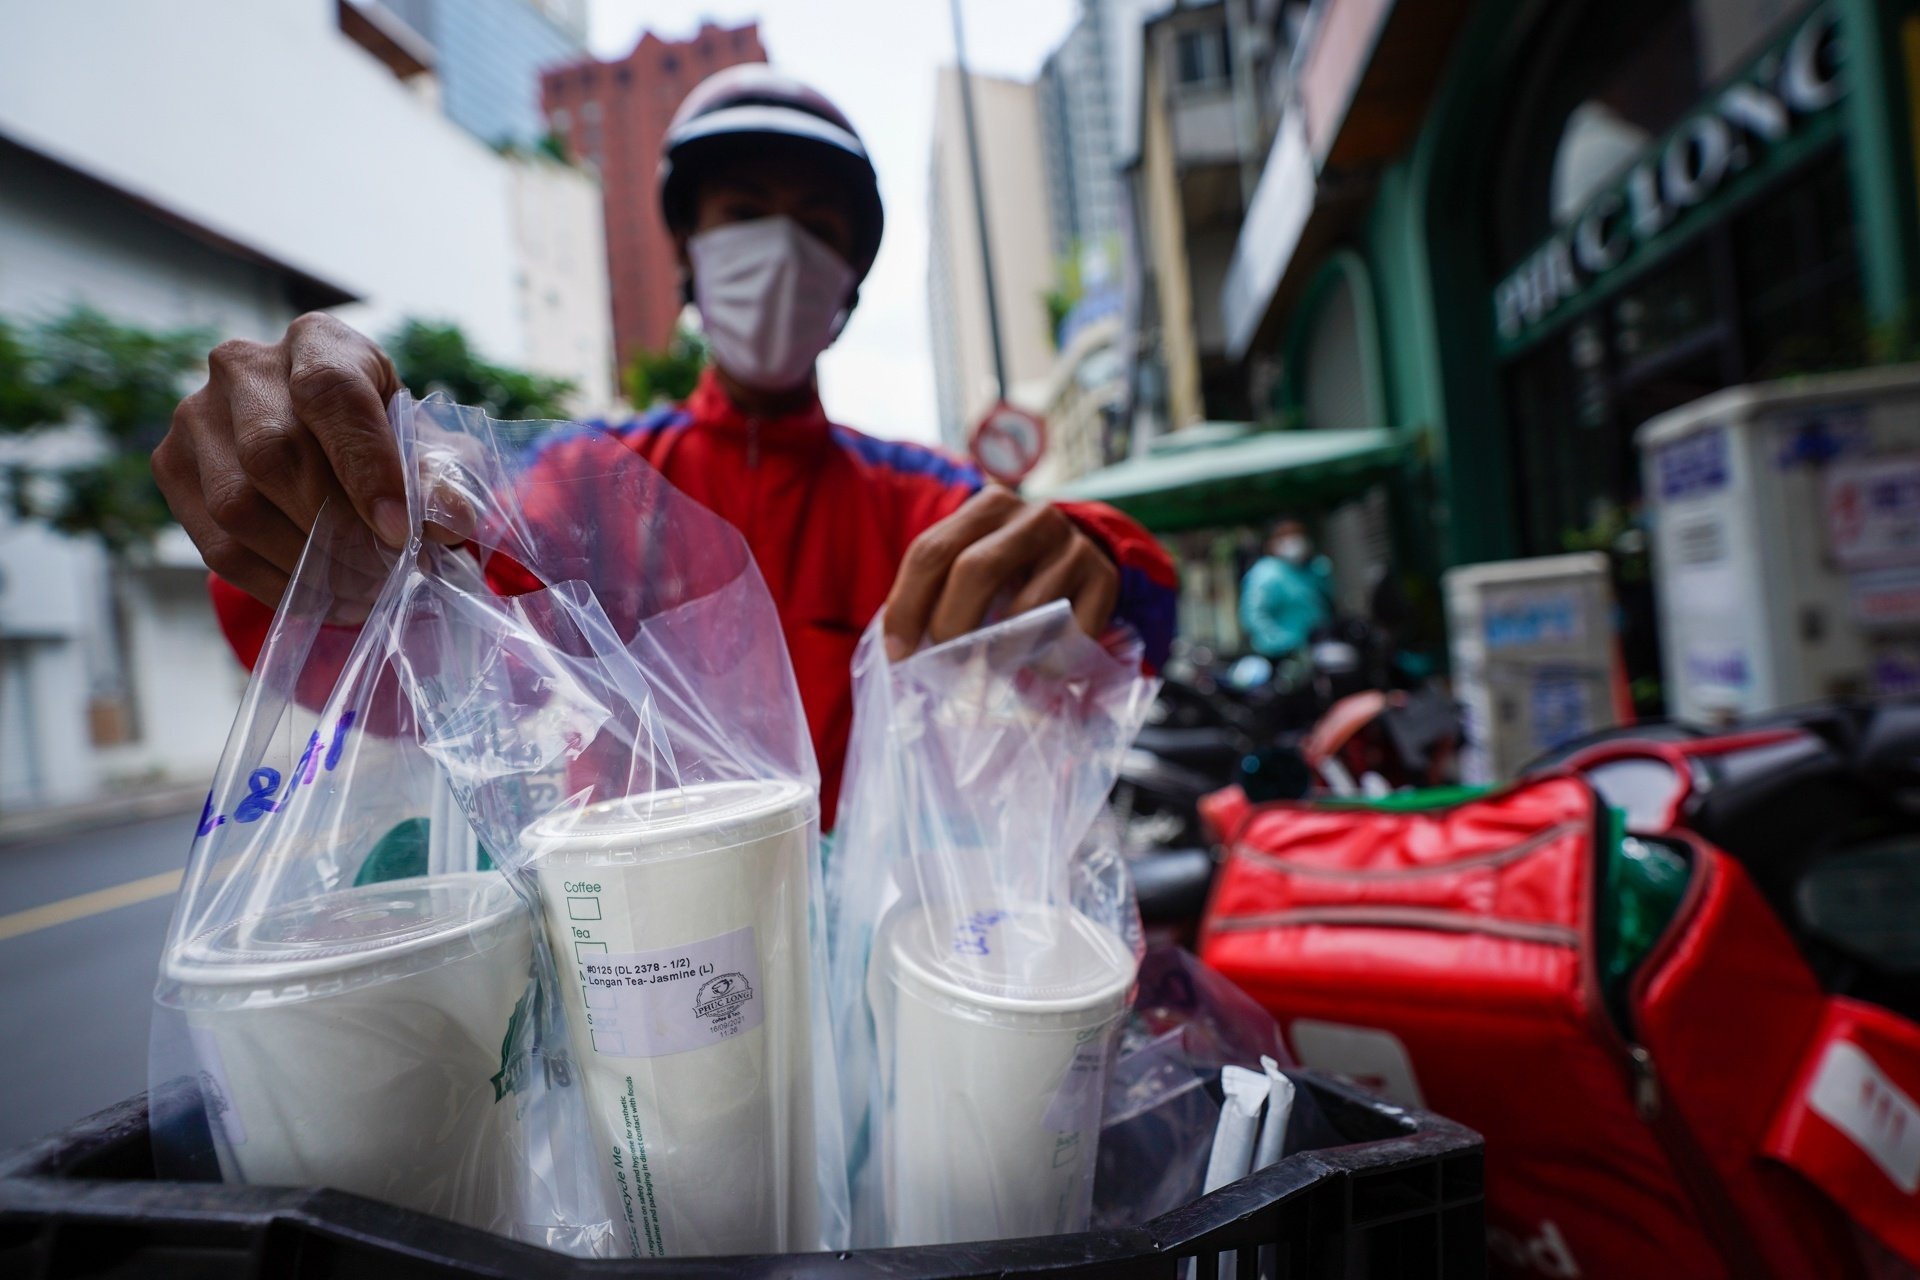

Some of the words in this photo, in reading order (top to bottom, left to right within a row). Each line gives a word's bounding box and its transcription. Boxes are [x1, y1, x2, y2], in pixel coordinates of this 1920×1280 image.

[563, 881, 602, 893] Coffee
[571, 926, 591, 939] Tea
[586, 964, 613, 975] #0125
[614, 965, 633, 977] (DL
[634, 962, 660, 974] 2378
[670, 957, 690, 969] 1/2)
[589, 976, 623, 988] Longan
[625, 976, 647, 987] Tea-
[649, 968, 696, 985] Jasmine
[698, 962, 714, 977] (L)
[726, 992, 750, 1004] LONG
[710, 1015, 746, 1034] 16/09/2021
[626, 1075, 635, 1097] foods
[620, 1096, 632, 1129] synthetic
[629, 1097, 637, 1114] with
[633, 1114, 643, 1141] contact
[612, 1145, 624, 1169] Me
[638, 1142, 647, 1163] direct
[633, 1169, 642, 1183] and
[617, 1171, 634, 1224] Recycle
[638, 1185, 646, 1206] safety
[644, 1172, 656, 1208] packaging
[641, 1205, 648, 1216] on
[650, 1208, 658, 1223] and
[643, 1216, 655, 1250] regulation
[653, 1222, 665, 1256] container
